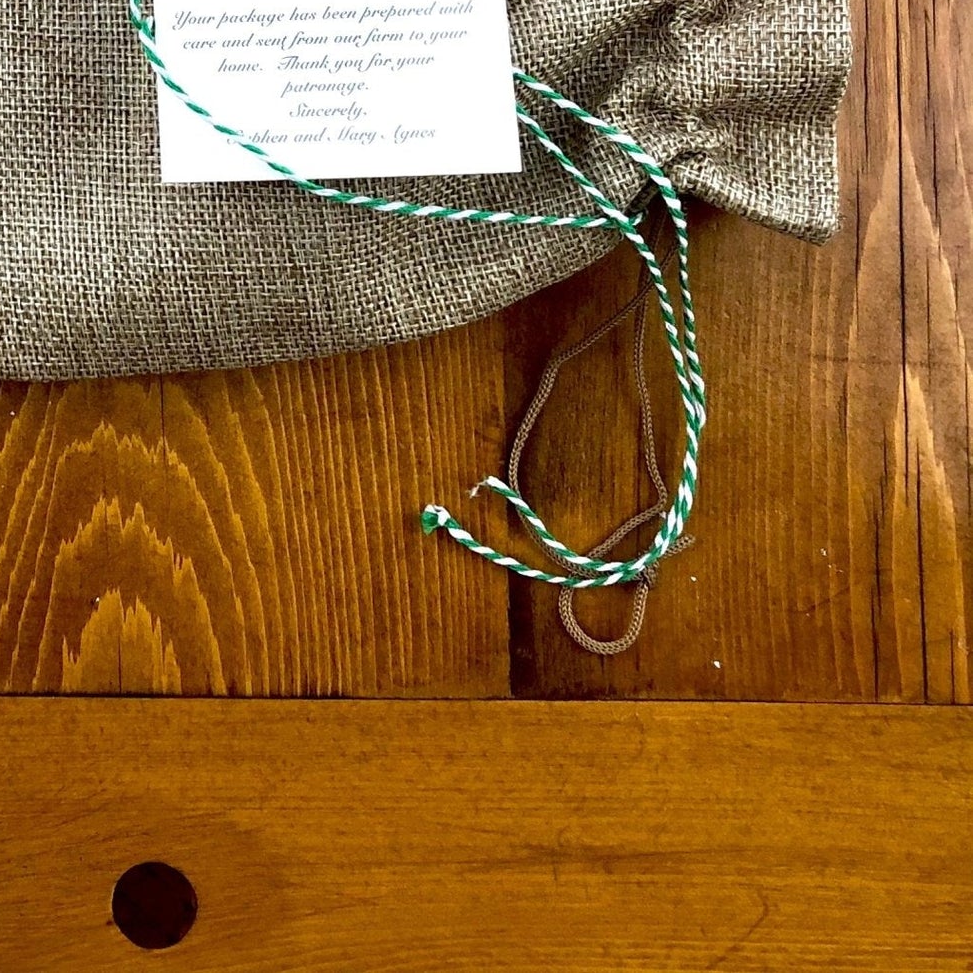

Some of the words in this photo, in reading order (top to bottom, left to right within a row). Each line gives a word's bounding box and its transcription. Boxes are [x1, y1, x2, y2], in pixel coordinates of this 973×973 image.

[172, 10, 215, 30] Your
[216, 8, 285, 29] package
[289, 6, 317, 21] has
[322, 5, 357, 20] been
[358, 1, 437, 24] prepared
[439, 0, 474, 15] with
[183, 39, 217, 49] care
[222, 33, 254, 48] and
[256, 35, 287, 48] sent
[281, 30, 328, 50] from
[334, 35, 362, 44] our
[355, 28, 404, 48] farm
[409, 30, 424, 41] to
[424, 30, 468, 45] your
[217, 58, 263, 72] home.
[277, 54, 330, 70] Thank
[329, 58, 363, 74] you
[358, 53, 392, 72] for
[391, 55, 435, 71] your
[280, 81, 369, 98] patronage.
[293, 127, 328, 141] and
[327, 125, 377, 145] Mary
[380, 124, 436, 144] Agnes
